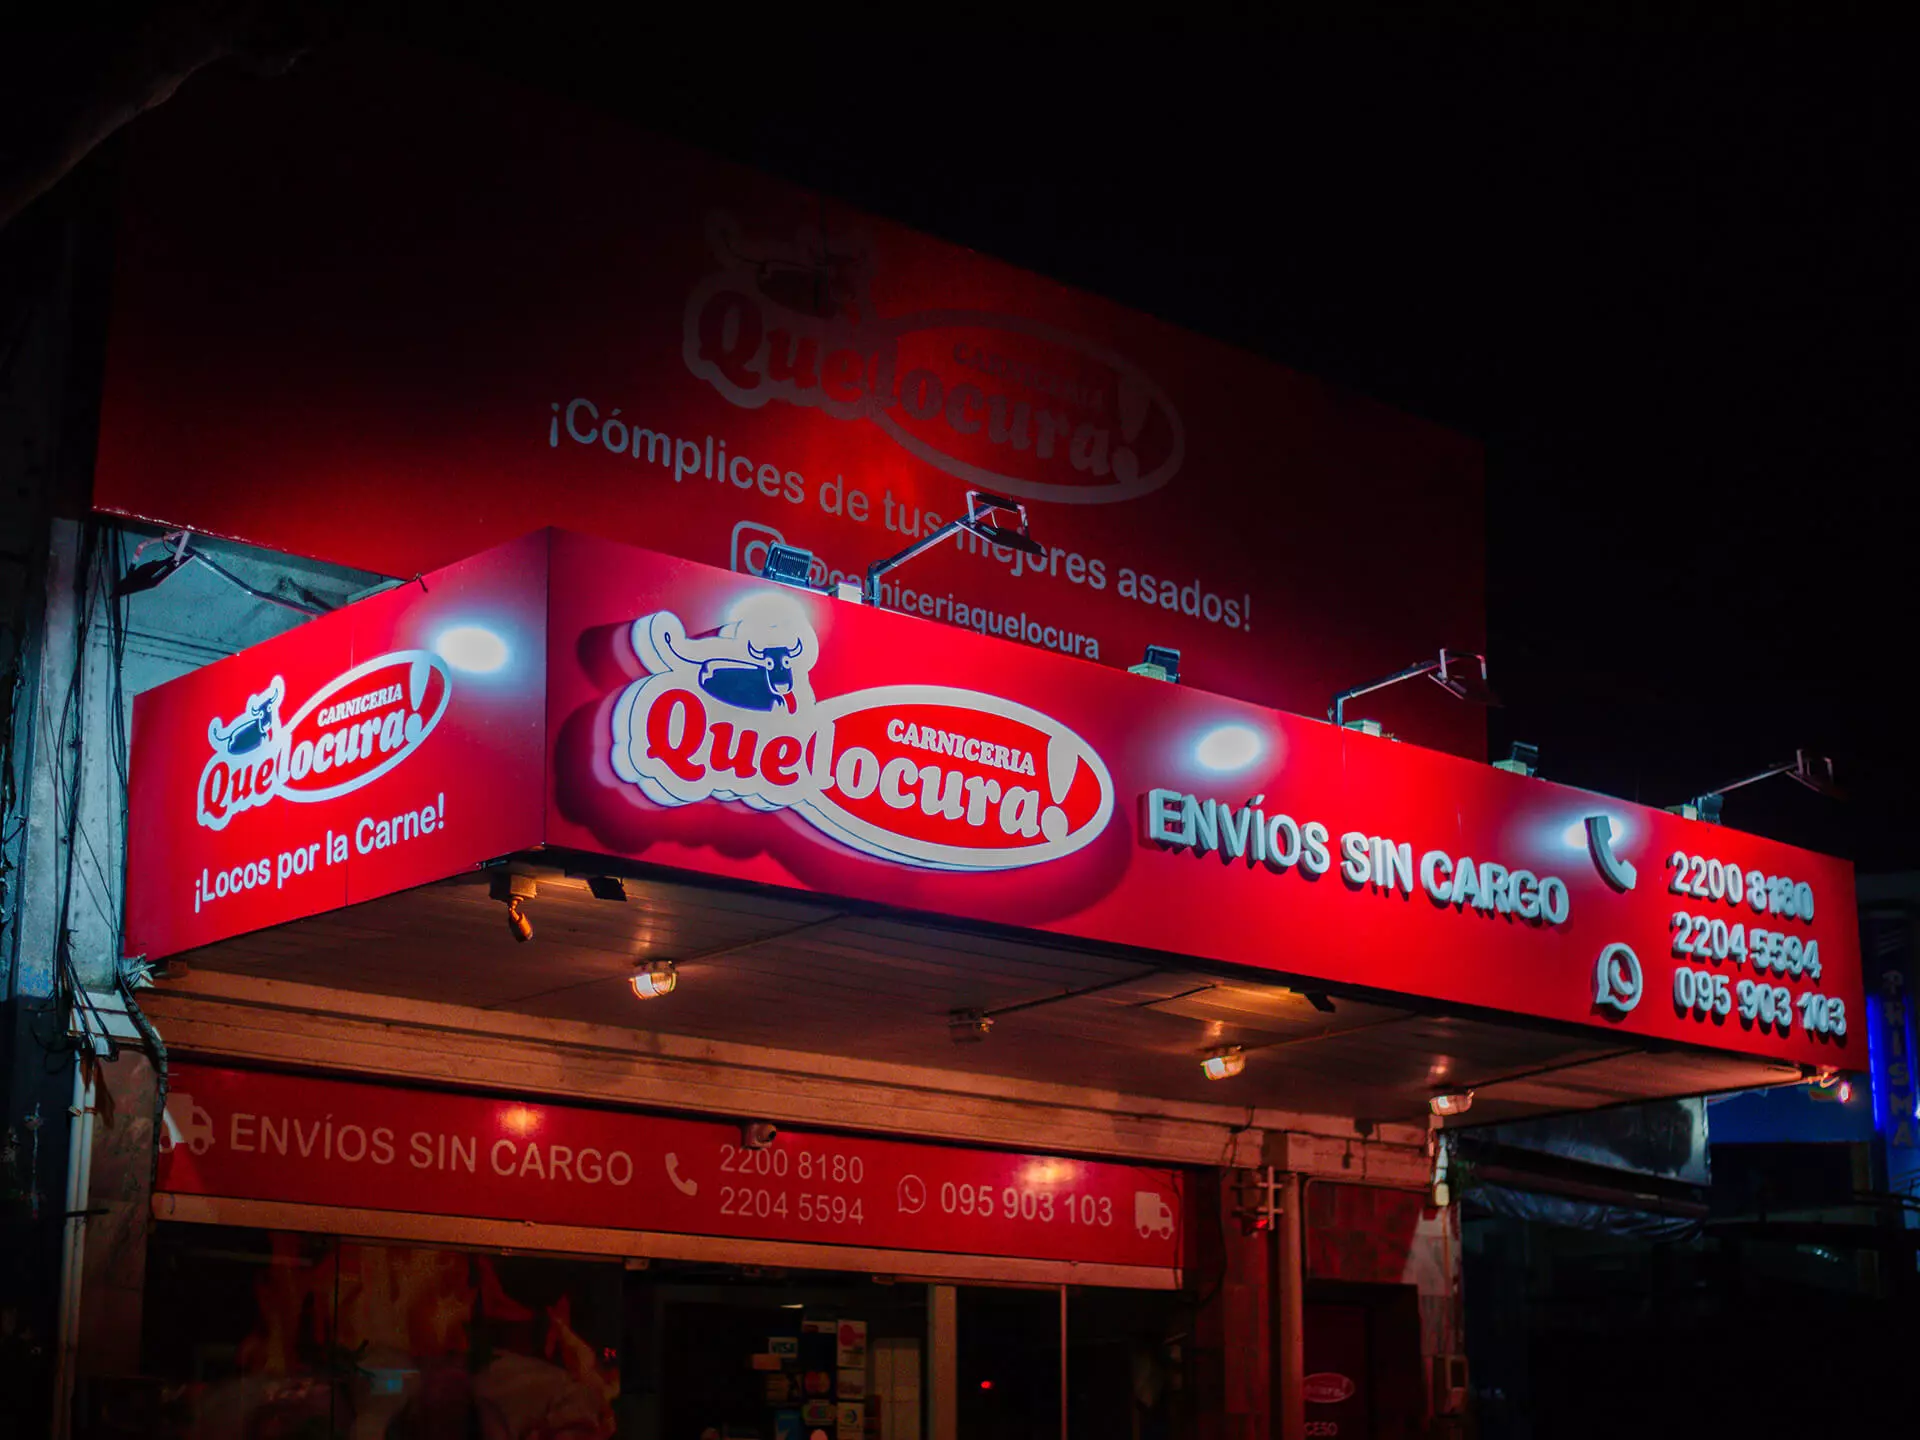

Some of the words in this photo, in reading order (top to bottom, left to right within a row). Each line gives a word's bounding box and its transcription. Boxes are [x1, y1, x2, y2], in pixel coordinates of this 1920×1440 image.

[549, 398, 805, 504] ¡Cómplices
[818, 474, 870, 522] de
[883, 489, 944, 538] tus
[1117, 566, 1251, 632] asados!
[317, 683, 403, 727] CARNICERIA
[887, 718, 1036, 776] CARNICERIA
[195, 858, 271, 913] ¡Locos
[277, 842, 320, 889] por
[326, 829, 349, 866] la
[355, 792, 445, 855] Carne!
[1146, 788, 1331, 875] ENVÍOS
[1340, 831, 1413, 893] SIN
[1420, 849, 1570, 924] CARGO
[1671, 850, 1743, 904] 2200
[1745, 869, 1814, 921] 8180
[1672, 910, 1748, 964] 2204
[1749, 927, 1822, 979] 5594
[1674, 966, 1731, 1015] 095
[1736, 979, 1792, 1027] 903
[1797, 991, 1847, 1036] 103
[229, 1112, 396, 1165] ENVÍOS
[409, 1130, 477, 1174] SIN
[490, 1138, 635, 1187] CARGO
[719, 1144, 789, 1178] 2200
[797, 1150, 864, 1184] 8180
[719, 1186, 788, 1220] 2204
[798, 1191, 864, 1226] 5594
[940, 1181, 994, 1218] 095
[1002, 1187, 1055, 1224] 903
[1063, 1193, 1113, 1228] 103
